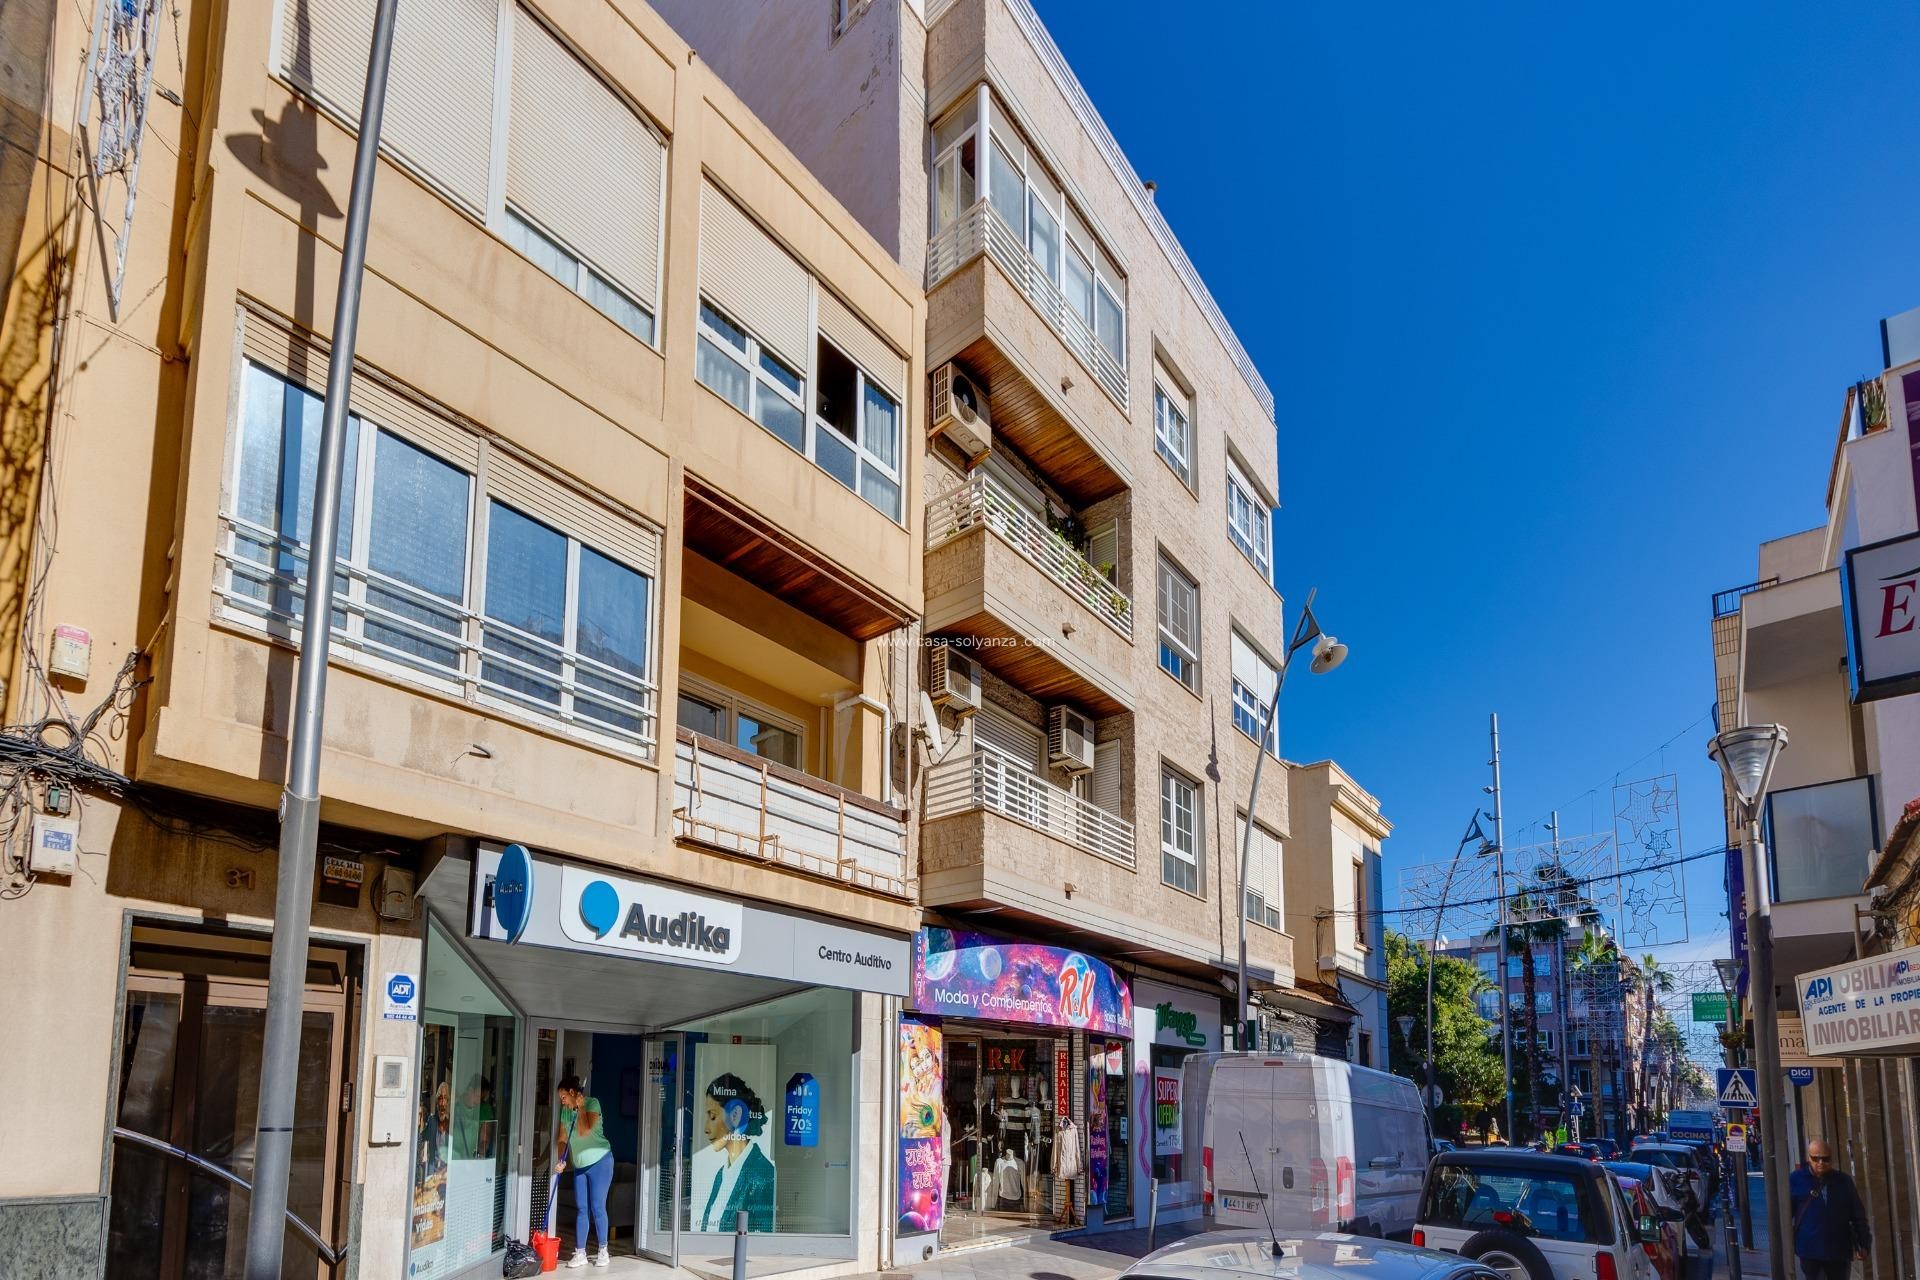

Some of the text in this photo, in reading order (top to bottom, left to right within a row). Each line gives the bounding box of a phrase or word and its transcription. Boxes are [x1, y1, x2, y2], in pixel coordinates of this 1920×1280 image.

[226, 868, 254, 889] 31
[499, 881, 523, 893] Audika
[620, 902, 731, 951] Audika
[818, 945, 892, 970] Centro Auditivo
[393, 984, 411, 995] ADT
[1805, 976, 1833, 1000] API
[934, 988, 1053, 1013] Moda y Complementos
[1818, 1003, 1847, 1016] AGENTE
[1856, 999, 1866, 1009] DE
[1874, 996, 1884, 1006] LA
[986, 1047, 1026, 1071] R&K
[1791, 1069, 1811, 1077] DIGI
[713, 1086, 737, 1096] Mima
[1158, 1080, 1178, 1101] SUPER
[748, 1110, 762, 1119] tus
[787, 1105, 813, 1117] Friday
[1671, 1131, 1711, 1140] COCINAS
